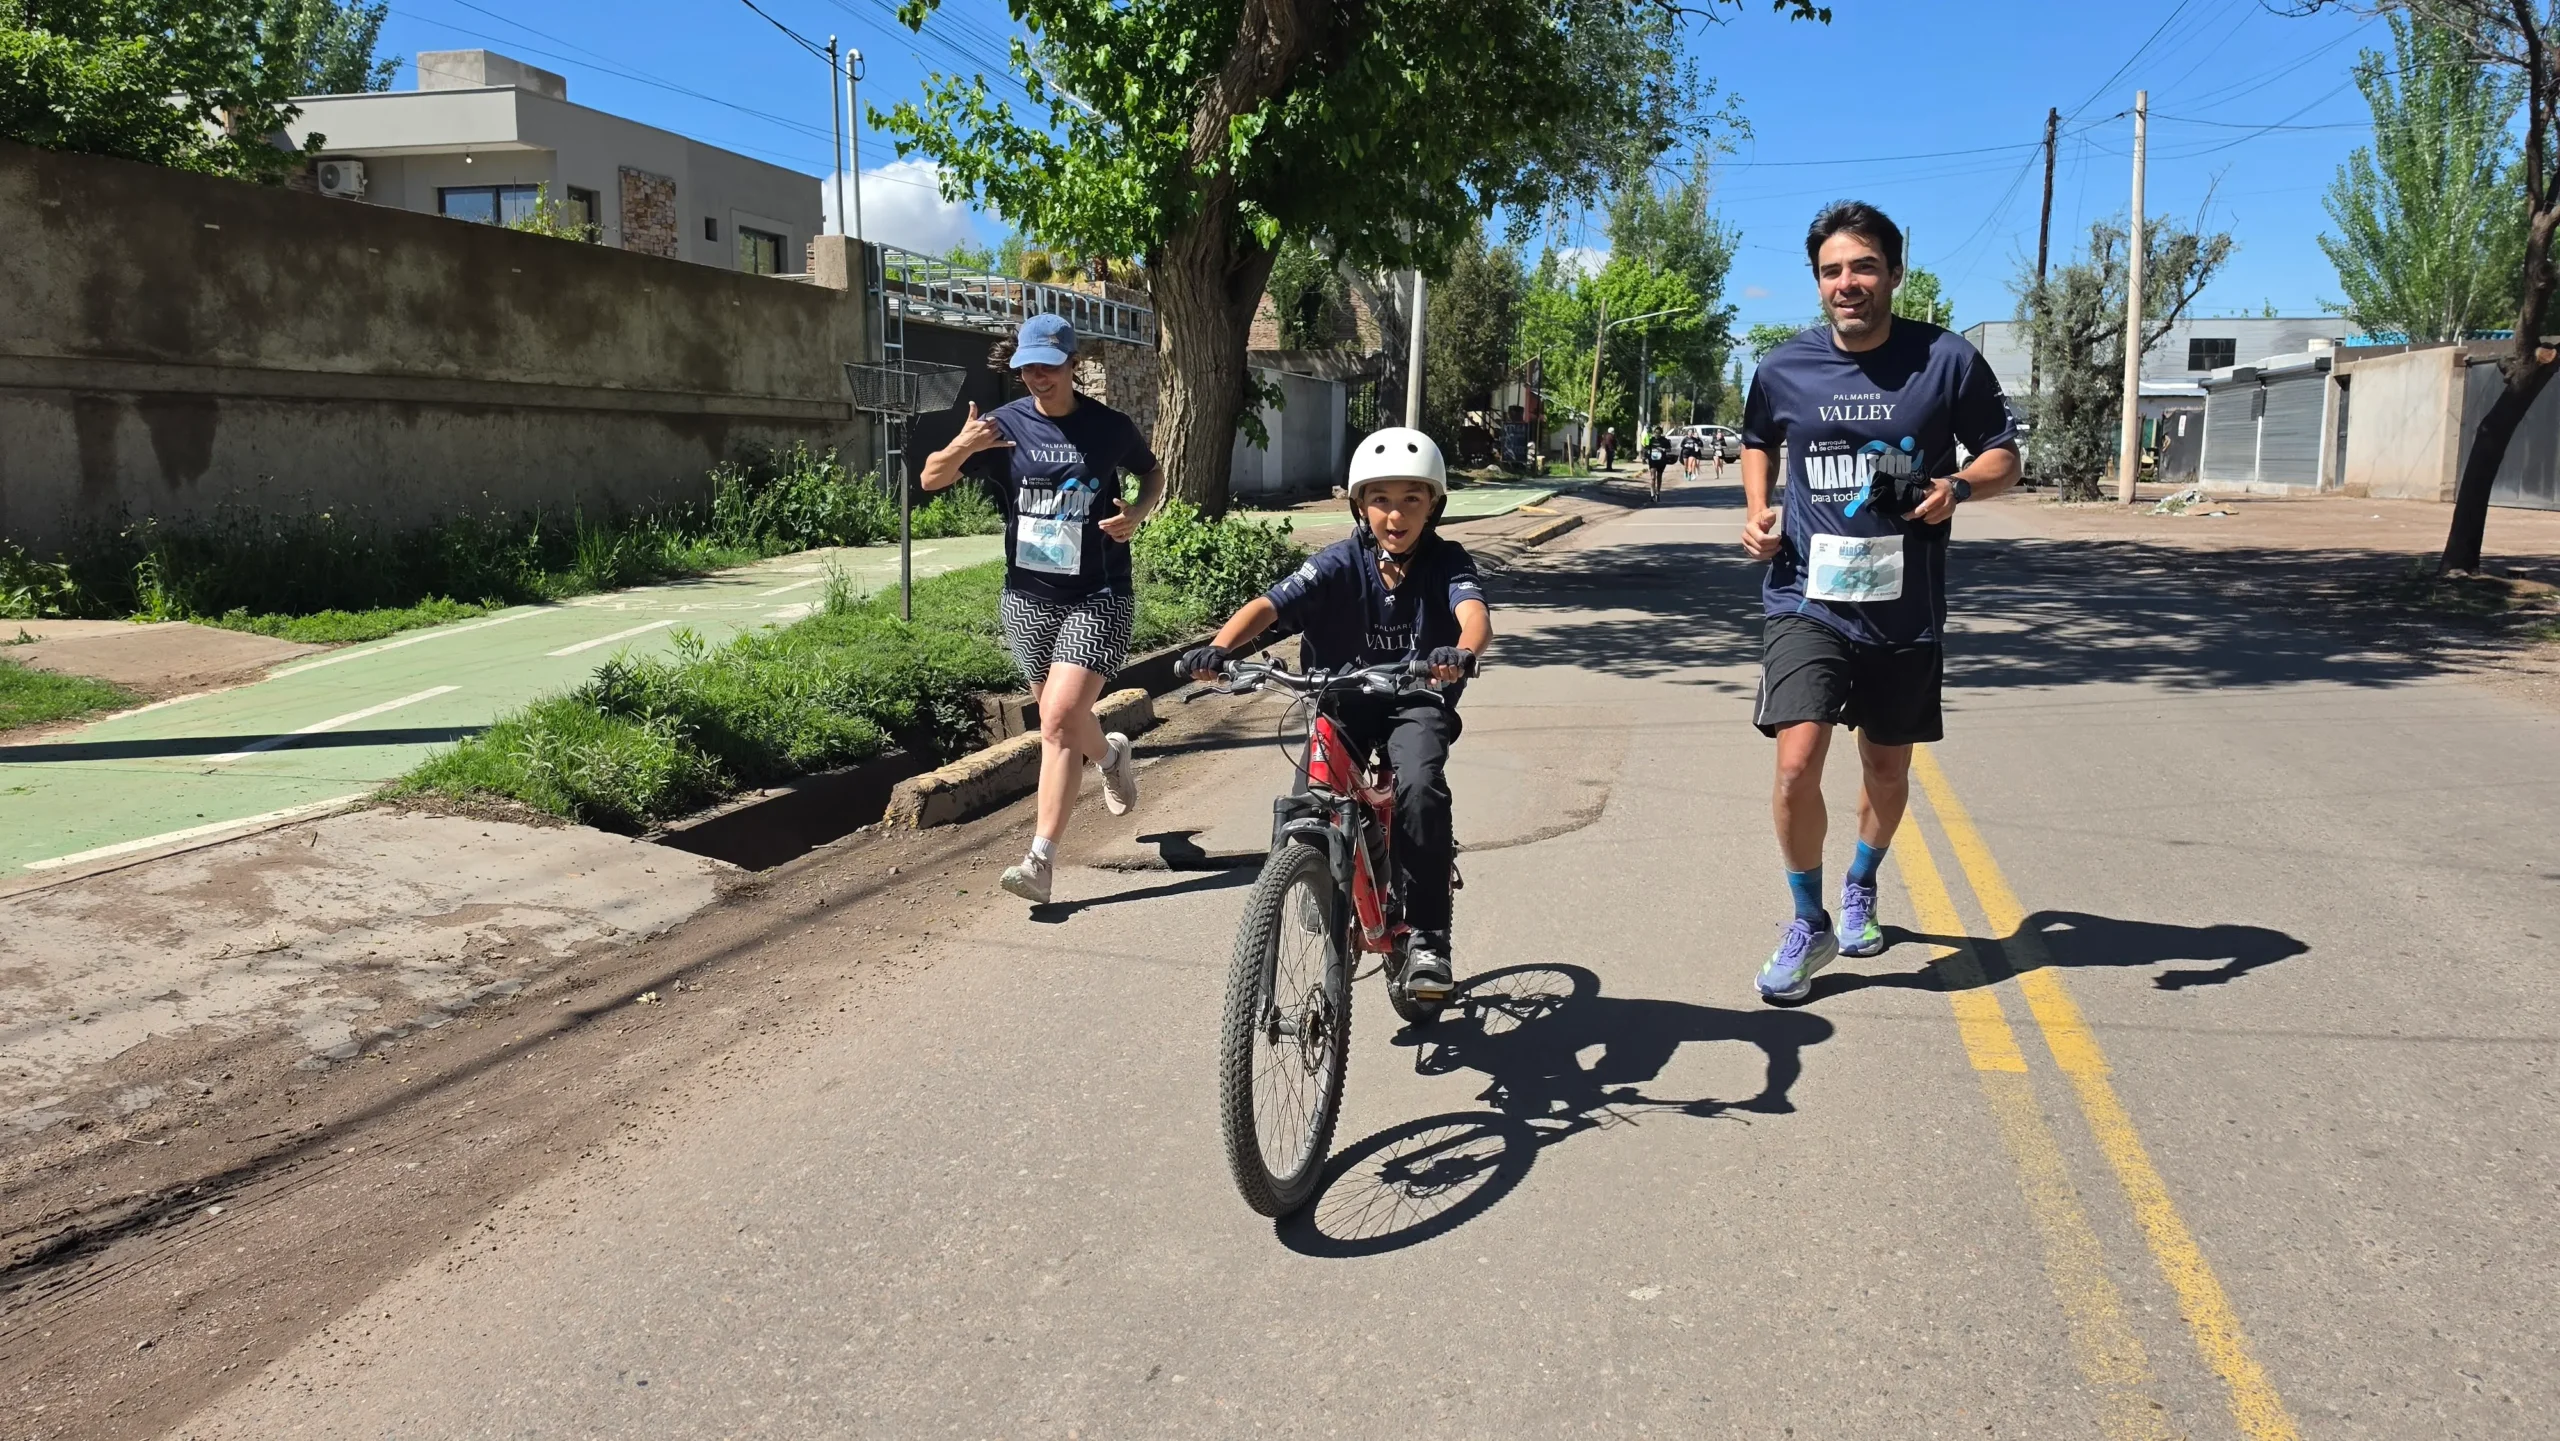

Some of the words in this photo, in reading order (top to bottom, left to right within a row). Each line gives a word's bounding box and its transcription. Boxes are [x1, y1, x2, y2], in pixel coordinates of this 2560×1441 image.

[1833, 393, 1881, 401] PALMARES
[1818, 404, 1896, 422] VALLEY
[1818, 439, 1847, 448] parroquia
[1030, 449, 1088, 464] VALLEY
[1811, 493, 1832, 505] para
[1365, 632, 1419, 651] VALLY
